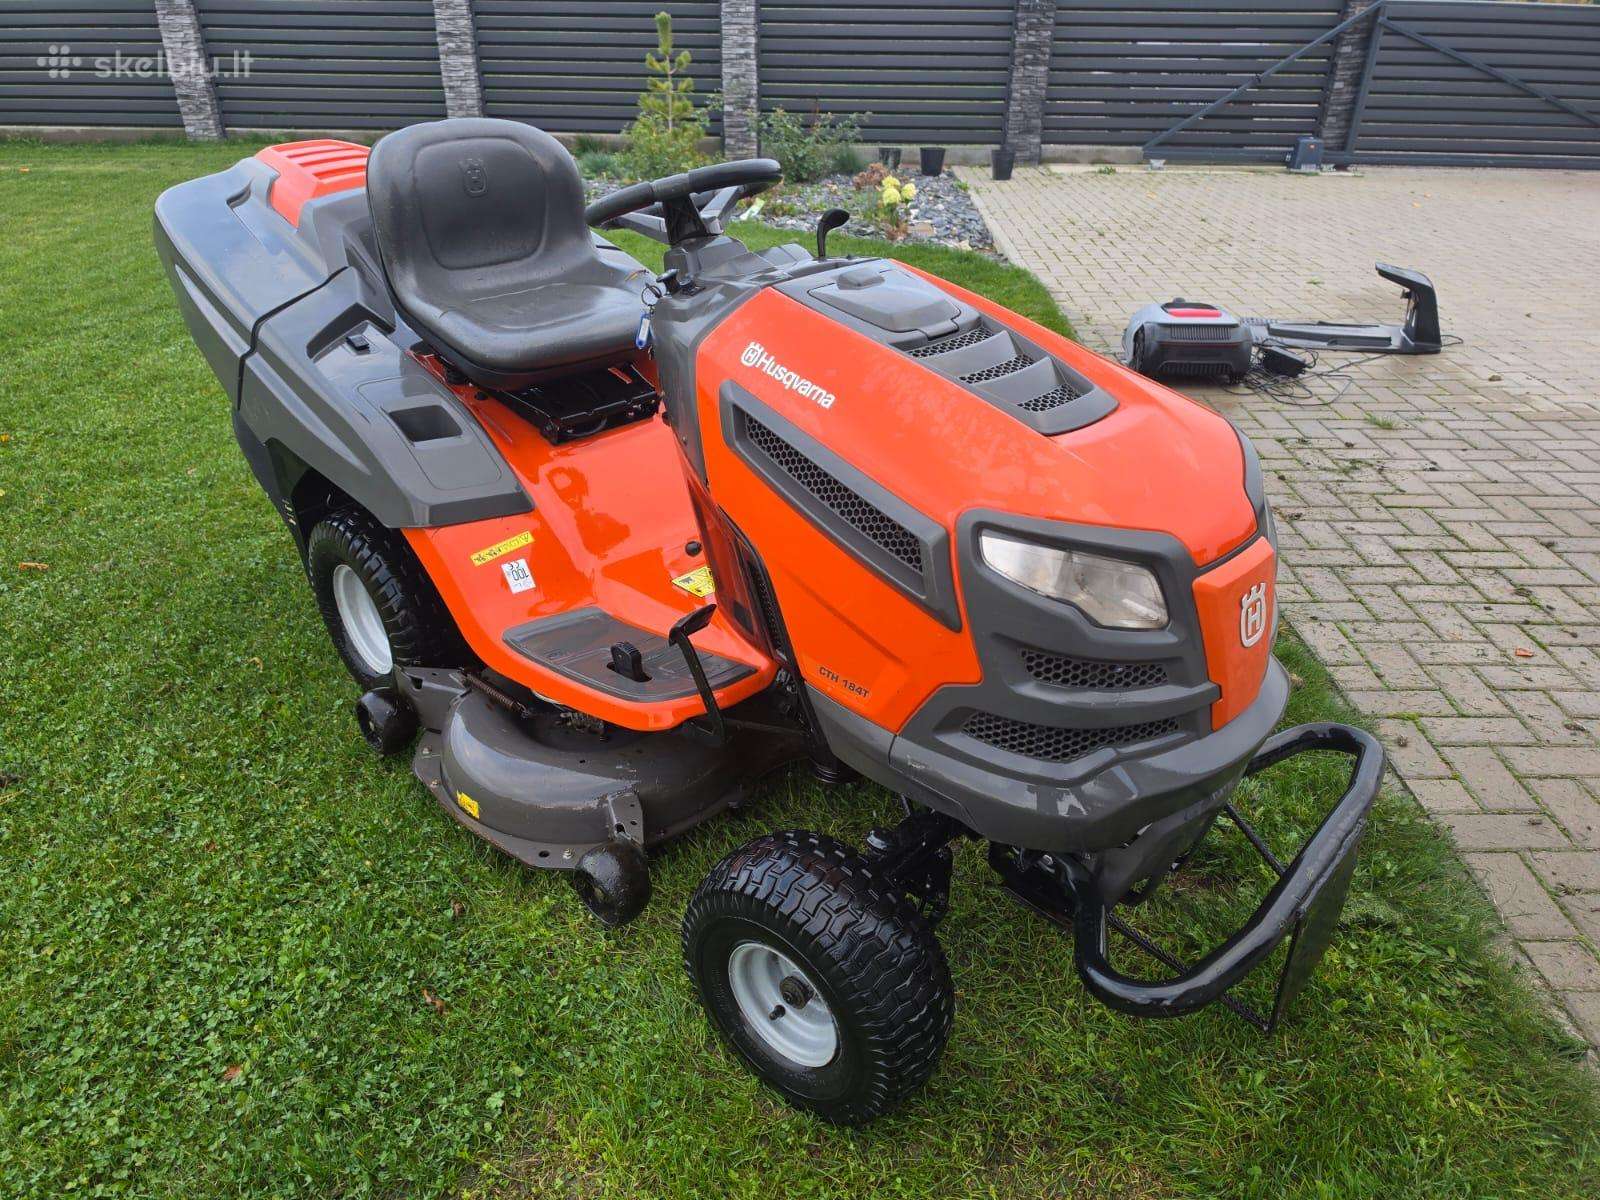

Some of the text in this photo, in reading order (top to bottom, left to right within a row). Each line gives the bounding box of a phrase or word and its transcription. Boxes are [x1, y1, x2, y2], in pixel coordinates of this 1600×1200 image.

[755, 351, 836, 409] Husqvarna
[511, 567, 529, 581] 100
[819, 666, 870, 698] CTH 184T
